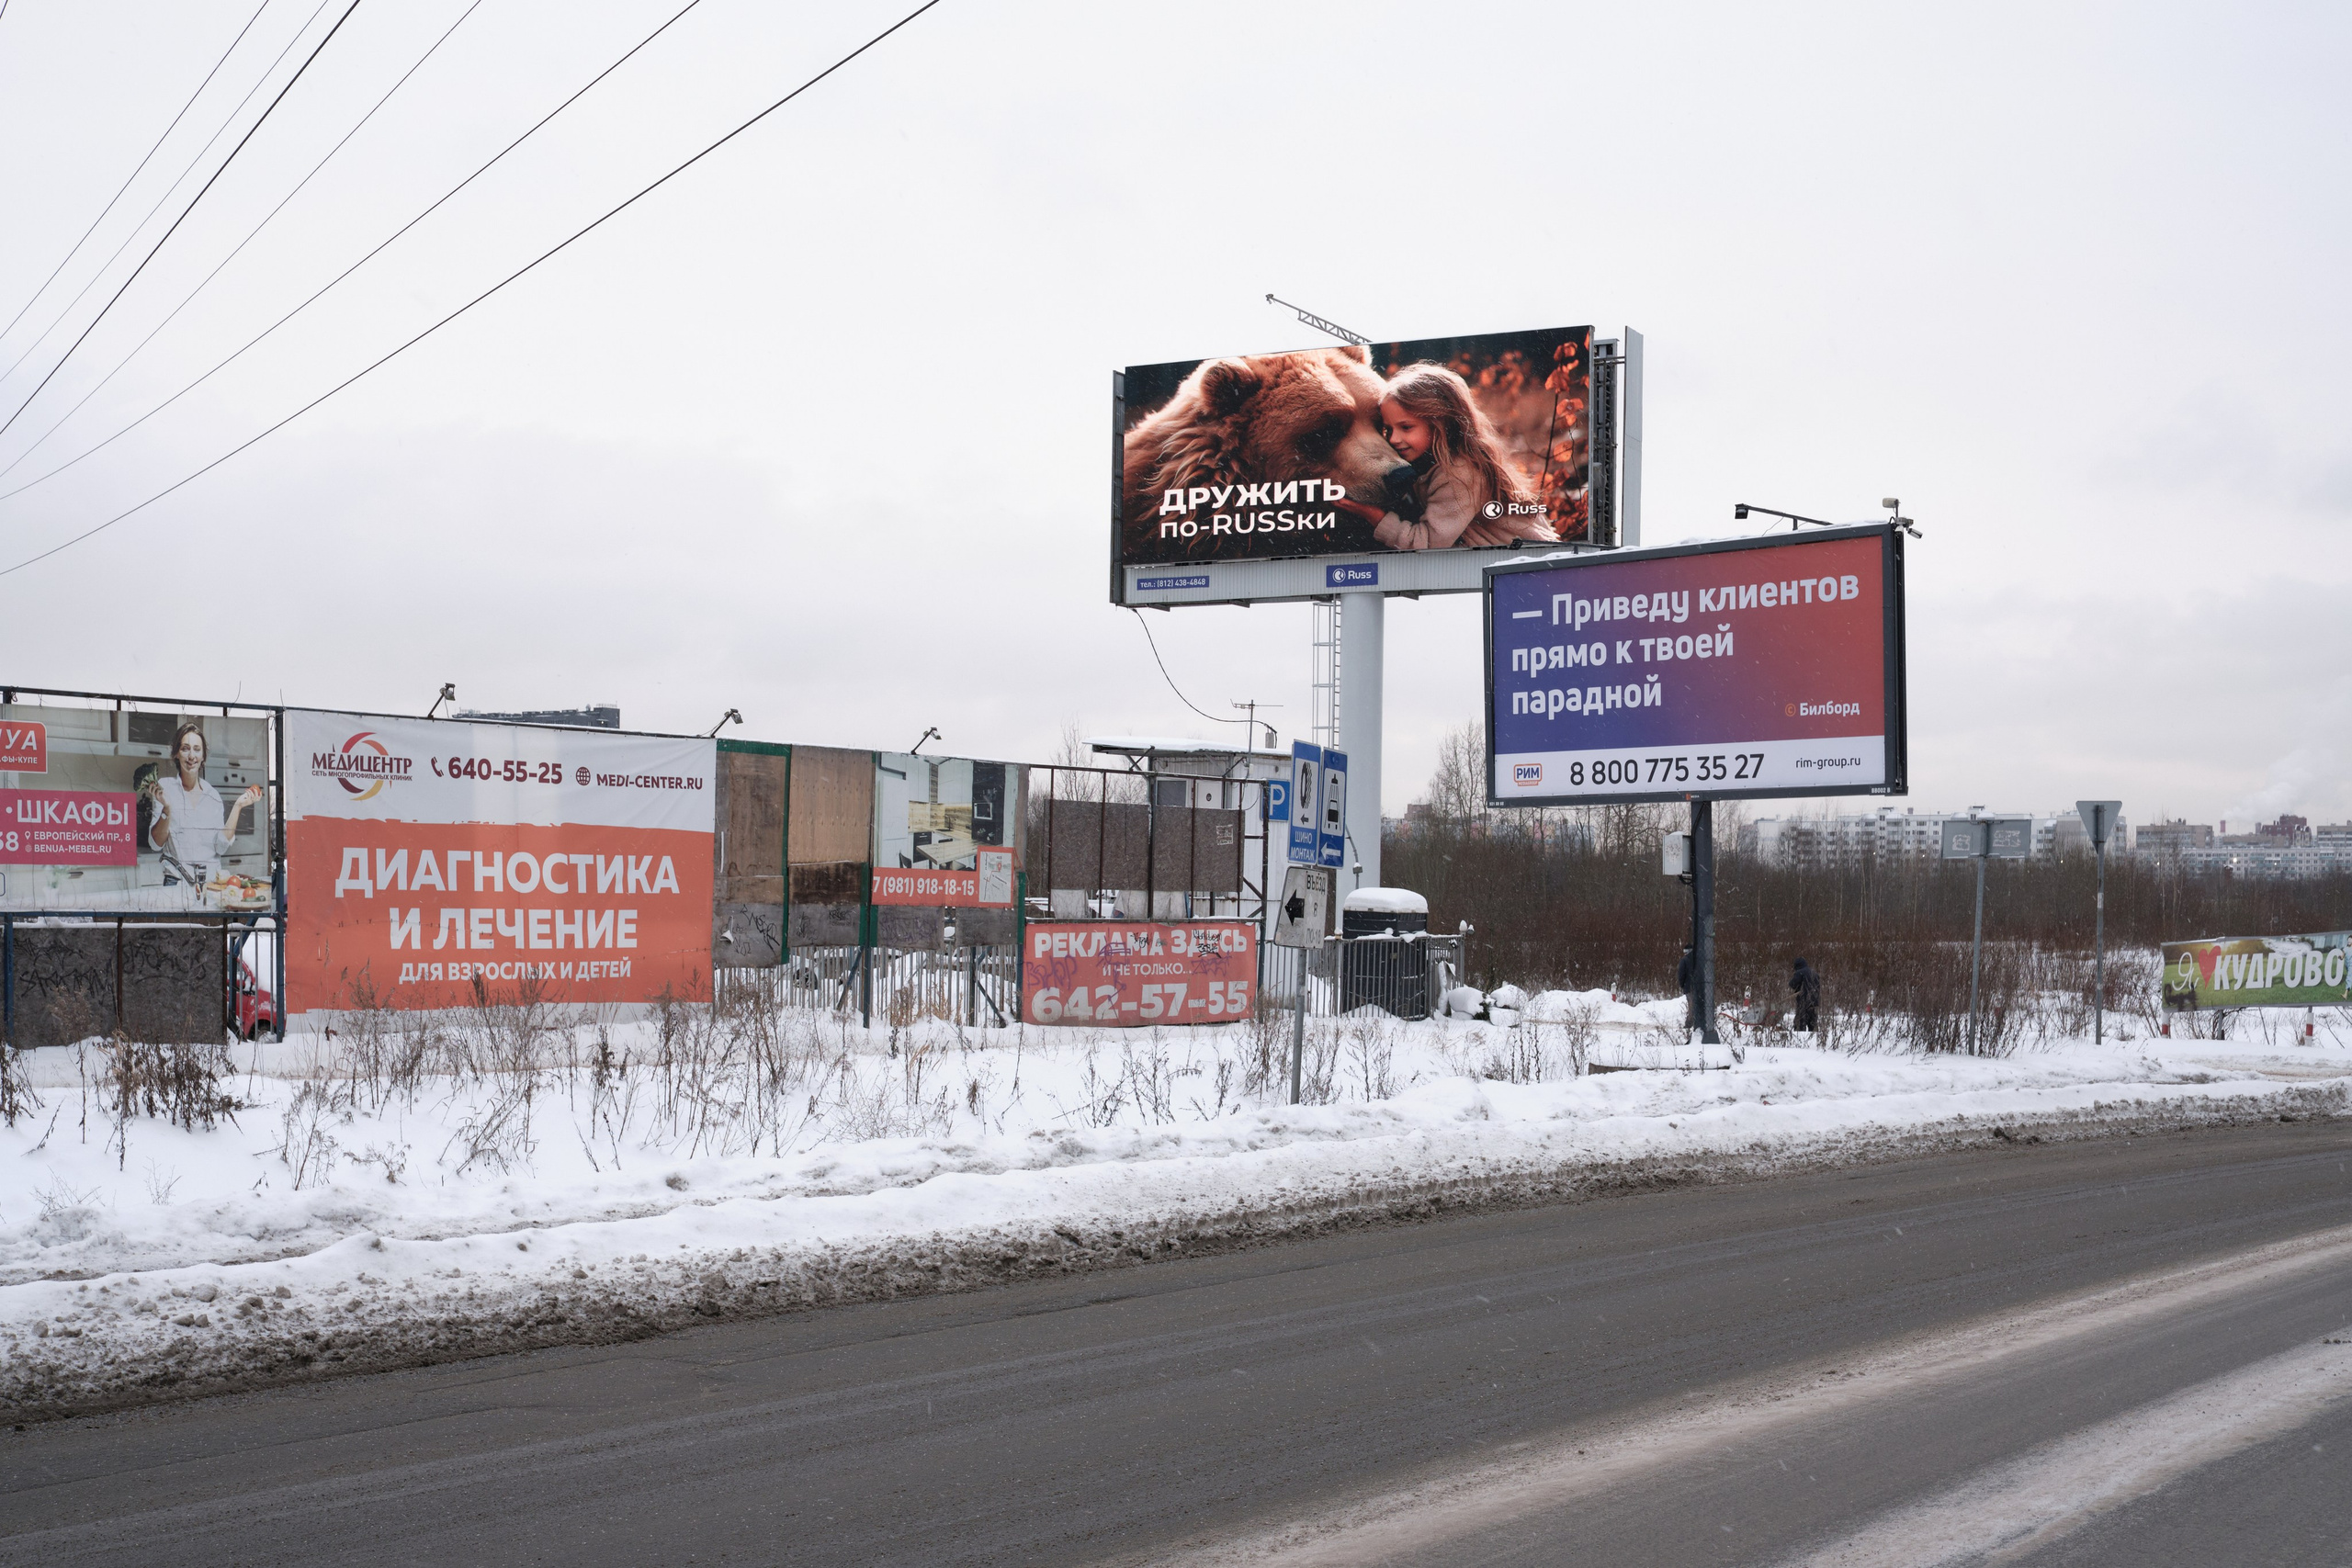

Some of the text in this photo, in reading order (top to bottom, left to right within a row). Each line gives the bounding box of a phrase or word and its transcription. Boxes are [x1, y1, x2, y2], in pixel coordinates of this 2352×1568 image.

[1159, 479, 1346, 516] ДРУЖИТЬ
[1508, 502, 1547, 514] Russ
[1157, 580, 1173, 588] (812)
[1174, 578, 1206, 587] 438-4848
[1348, 570, 1372, 580] Russ
[1553, 590, 1690, 630] Приведу
[1699, 574, 1860, 614] клиентов
[1512, 623, 1734, 678] прямо к твоей
[1512, 673, 1662, 721] парадной
[1799, 701, 1860, 717] Билборд
[0, 728, 37, 750] УА
[311, 750, 413, 774] МЕДИЦЕНТР
[448, 756, 563, 785] 640-55-25
[1516, 766, 1540, 779] РИМ
[1570, 753, 1765, 786] 8 800 775 35 27
[1795, 756, 1861, 771] rim-group.ru
[311, 769, 327, 777] СЕТЬ
[328, 771, 390, 780] МНОГОПРОФИЛЬНЫХ
[596, 773, 704, 791] MEDI-CENTER.RU
[17, 799, 129, 826] ШКАФЫ
[34, 829, 105, 840] ЕВРОПЕЙСКИЙ
[125, 833, 130, 841] 8
[1295, 830, 1313, 844] ШИНО
[34, 844, 112, 853] BENUA-MEBEL.RU
[1290, 847, 1316, 861] МОНТАЖ
[334, 846, 681, 899] ДИАГНОСТИКА
[883, 875, 915, 897] (981)
[917, 876, 975, 897] 918-18-15
[1306, 874, 1326, 896] ВЪЕЗД
[390, 907, 639, 951] И ЛЕЧЕНИЕ
[1035, 931, 1164, 959] РЕКЛАМА
[1170, 929, 1248, 958] ЗДЕСЬ
[399, 955, 632, 986] ДЛЯ ВЗРОСЛЫХ И ДЕТЕЙ
[1102, 966, 1112, 976] И
[1115, 965, 1131, 976] НЕ
[2172, 948, 2344, 991] Я КУДРОВО
[1031, 980, 1249, 1024] 642-57-55
